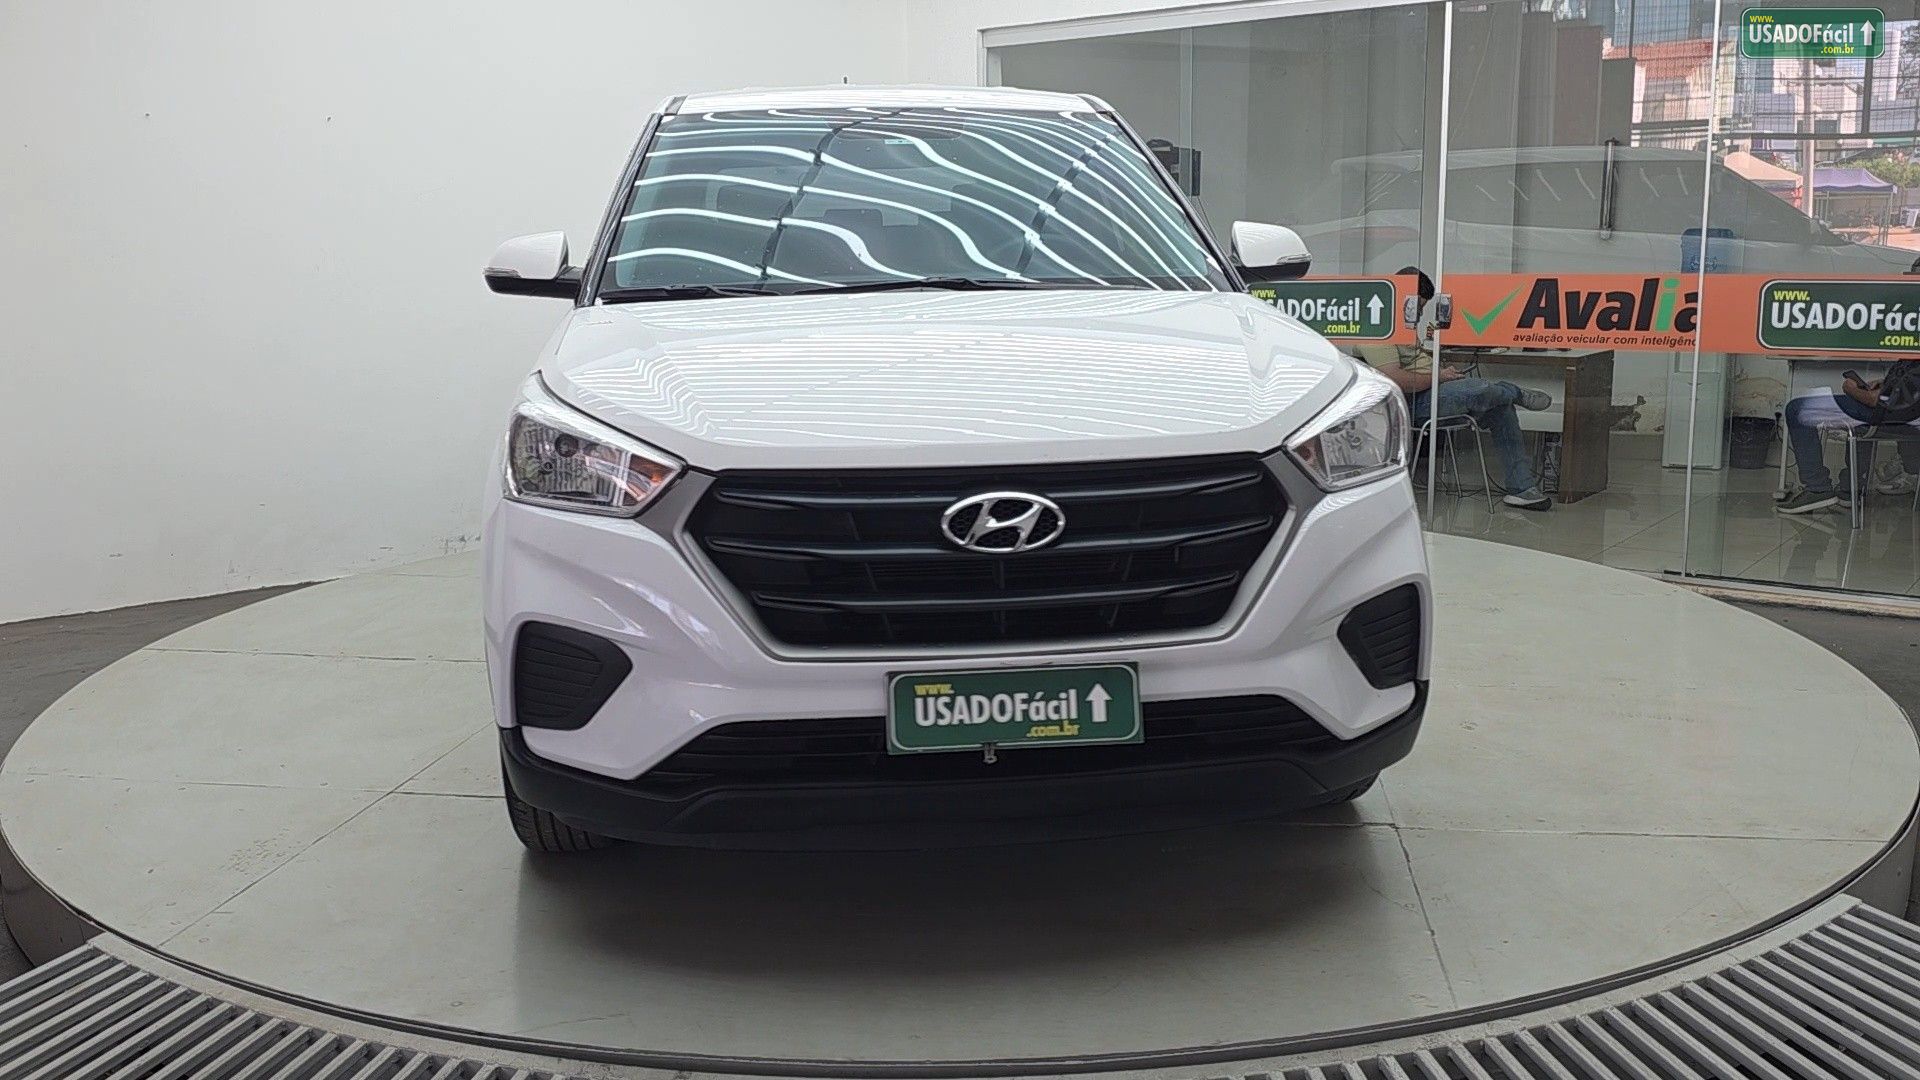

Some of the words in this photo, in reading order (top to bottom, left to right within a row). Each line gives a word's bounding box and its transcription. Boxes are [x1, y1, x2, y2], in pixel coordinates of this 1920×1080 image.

[1773, 290, 1811, 301] www.
[1323, 321, 1361, 334] .com.br
[1512, 333, 1564, 345] avaliação
[1567, 335, 1611, 345] veicular
[1613, 336, 1638, 346] com
[914, 683, 955, 696] www.
[914, 688, 1078, 727] USADOFácil
[1026, 720, 1080, 738] .com.br
